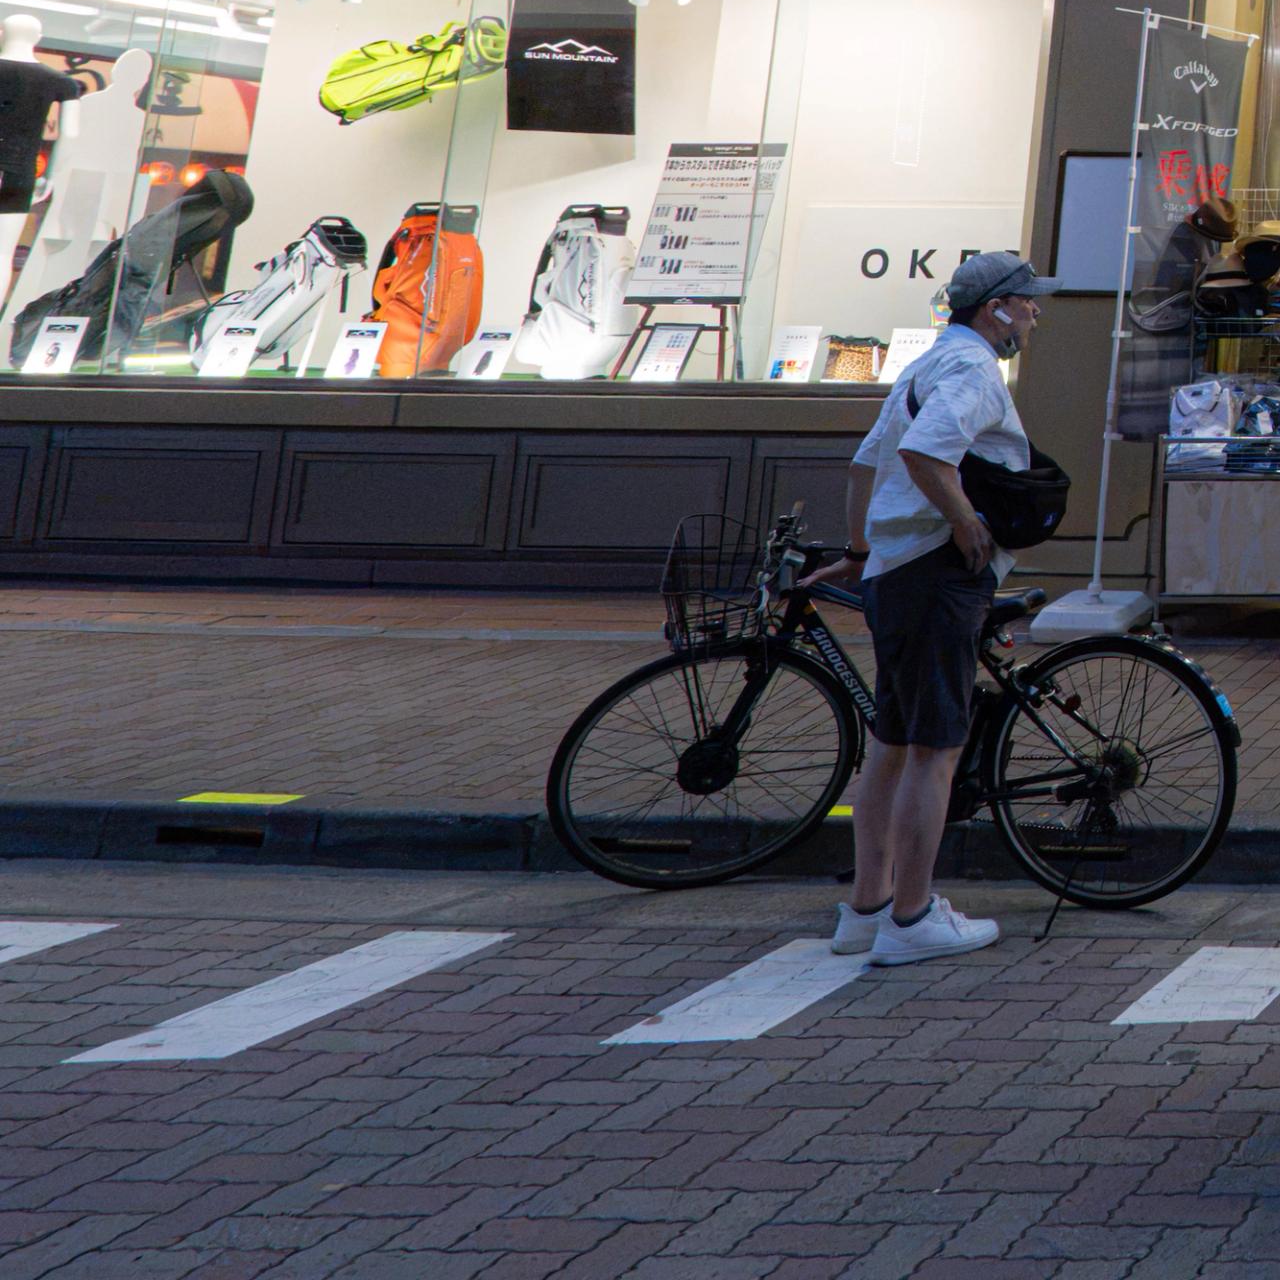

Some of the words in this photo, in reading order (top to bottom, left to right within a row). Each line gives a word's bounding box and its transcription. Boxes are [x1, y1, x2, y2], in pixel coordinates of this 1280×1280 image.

[524, 51, 550, 60] SUN
[552, 53, 616, 63] MOUNTAIN
[1173, 61, 1220, 88] Callaway
